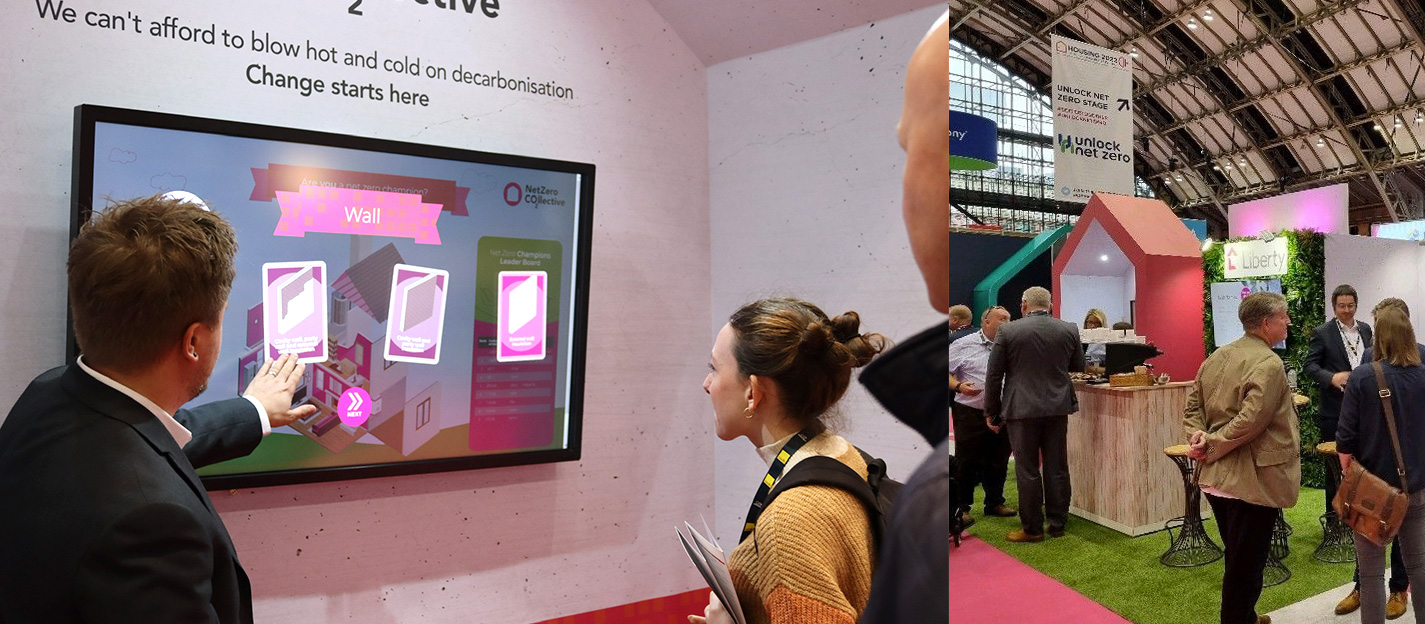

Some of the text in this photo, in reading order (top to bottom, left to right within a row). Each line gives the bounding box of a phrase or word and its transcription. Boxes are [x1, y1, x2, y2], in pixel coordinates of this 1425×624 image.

[36, 0, 574, 99] We can't afford to blow hot and cold on decarbonisation
[246, 63, 429, 106] Change starts here
[1057, 84, 1109, 101] UNLOCK NET
[1057, 94, 1108, 110] ZERO STAGE
[1075, 136, 1121, 152] unlock
[1075, 146, 1130, 163] net zero
[525, 184, 559, 196] NetZero
[344, 205, 381, 224] Wall
[1242, 250, 1285, 272] Liberty
